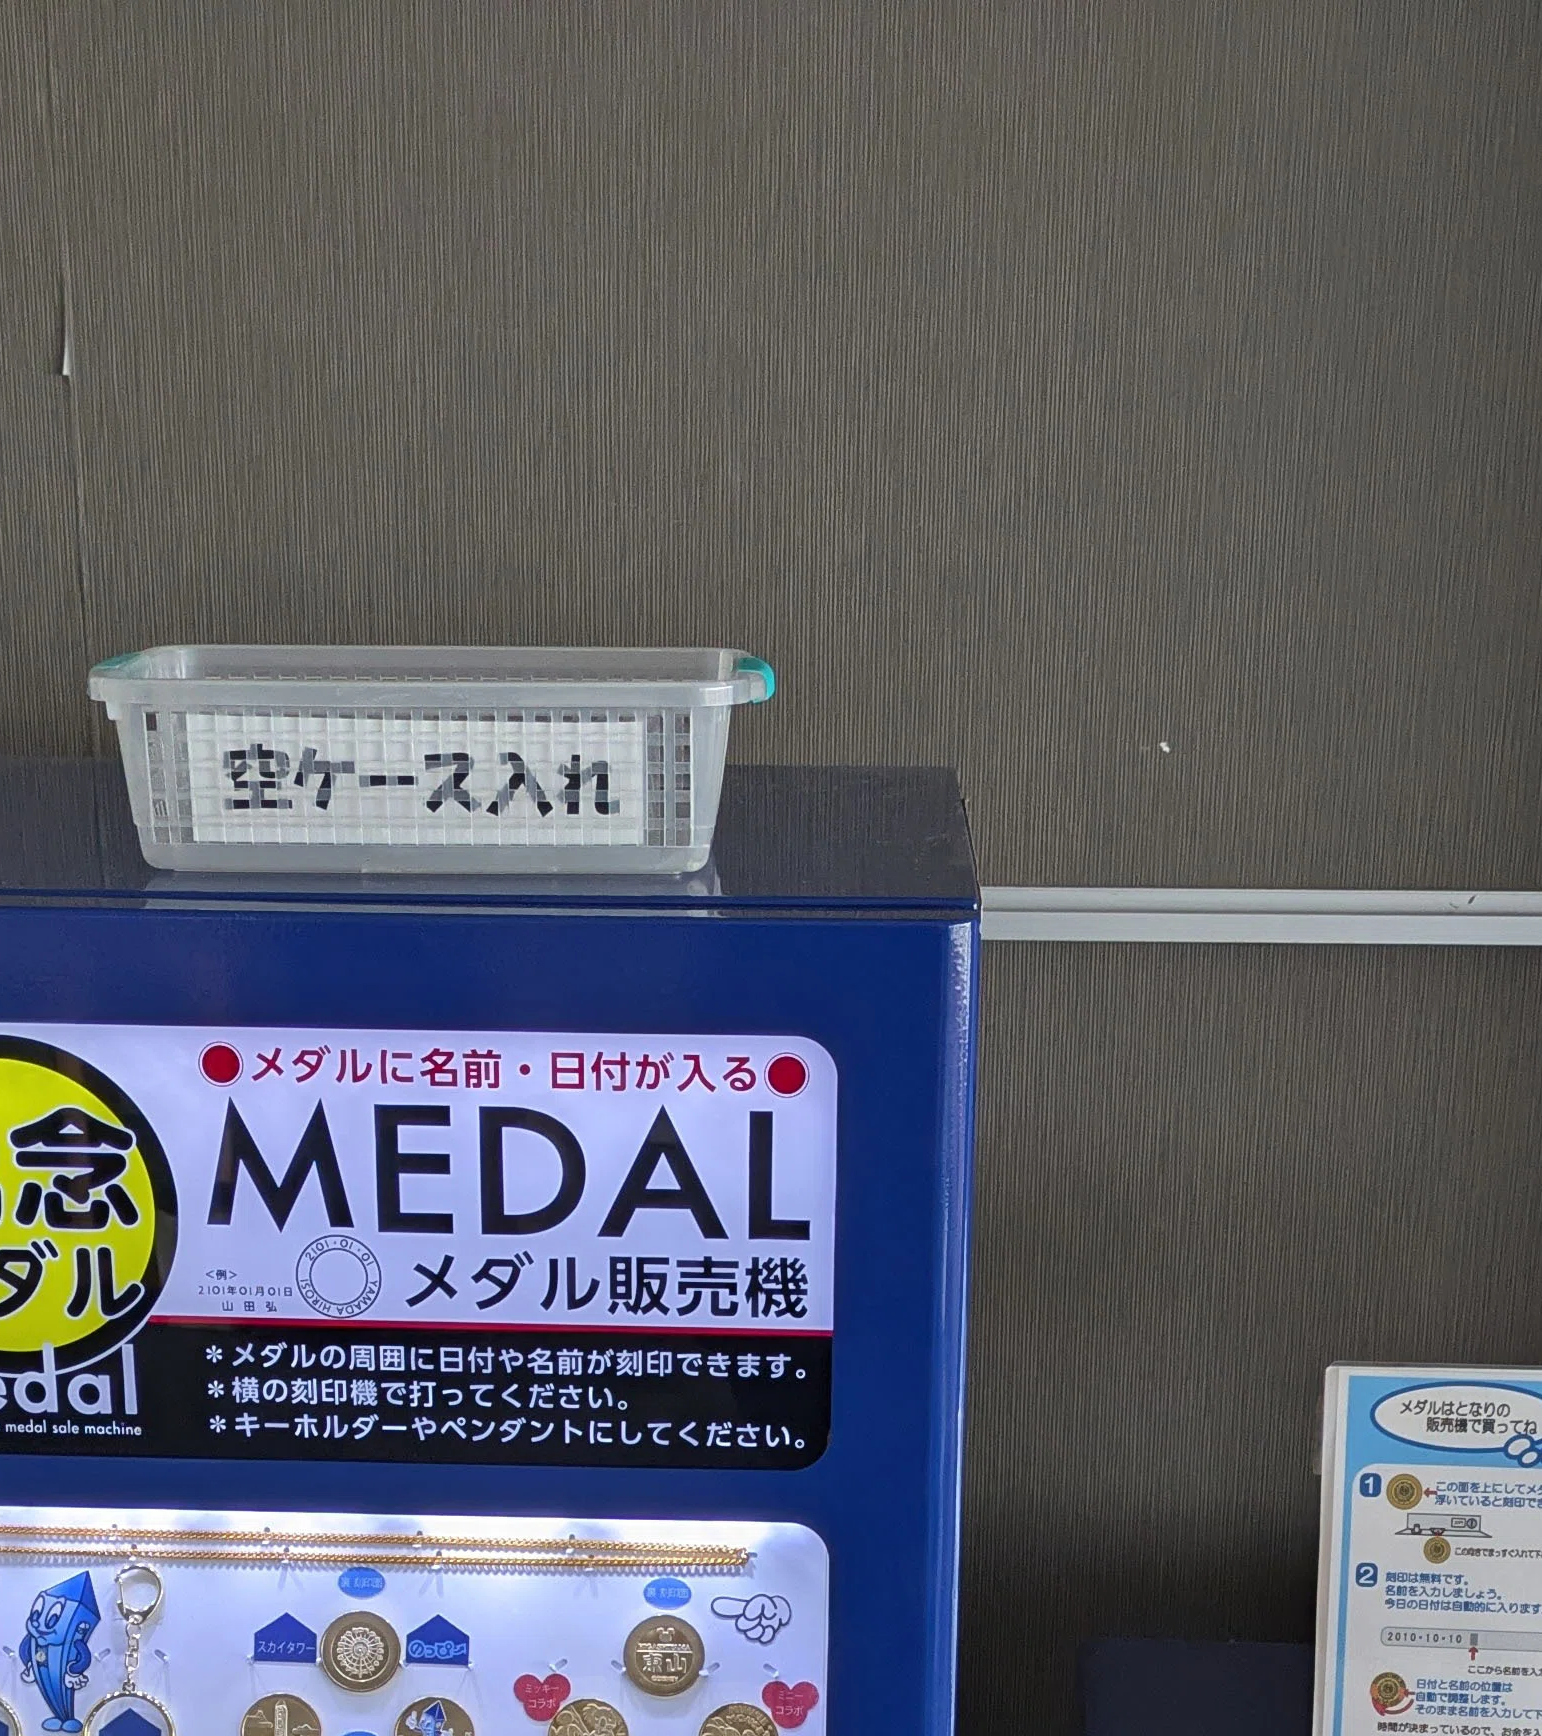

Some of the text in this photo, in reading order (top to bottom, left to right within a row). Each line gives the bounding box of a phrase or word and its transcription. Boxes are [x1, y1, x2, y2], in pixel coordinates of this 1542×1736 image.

[223, 743, 620, 816] 空ケース入れ
[251, 1046, 757, 1095] メダルに名前・日付が入る
[206, 1097, 811, 1240] MEDAL
[198, 1286, 292, 1297] 2101年01月01日
[406, 1255, 807, 1319] メダル販売機
[300, 1279, 331, 1312] HIROSI
[337, 1280, 378, 1315] YAMADA
[1400, 1399, 1511, 1417] メダルはとなりの
[6, 1420, 46, 1433] medal
[52, 1422, 79, 1435] sale
[85, 1422, 142, 1435] machine
[1426, 1418, 1537, 1435] 販売機で買ってね
[1364, 1477, 1375, 1493] 1
[1359, 1566, 1470, 1586] 2 刻印は無料です。
[1385, 1586, 1504, 1601] 名前を入力しましょう。
[258, 1641, 315, 1654] スカイタワー
[526, 1684, 559, 1694] ミッキー
[1416, 1679, 1513, 1693] 日付と名前の位置は
[529, 1698, 556, 1709] コラボ
[779, 1691, 804, 1701] ミニー
[1416, 1692, 1506, 1706] 自動で調整します。
[776, 1706, 804, 1716] コラボ
